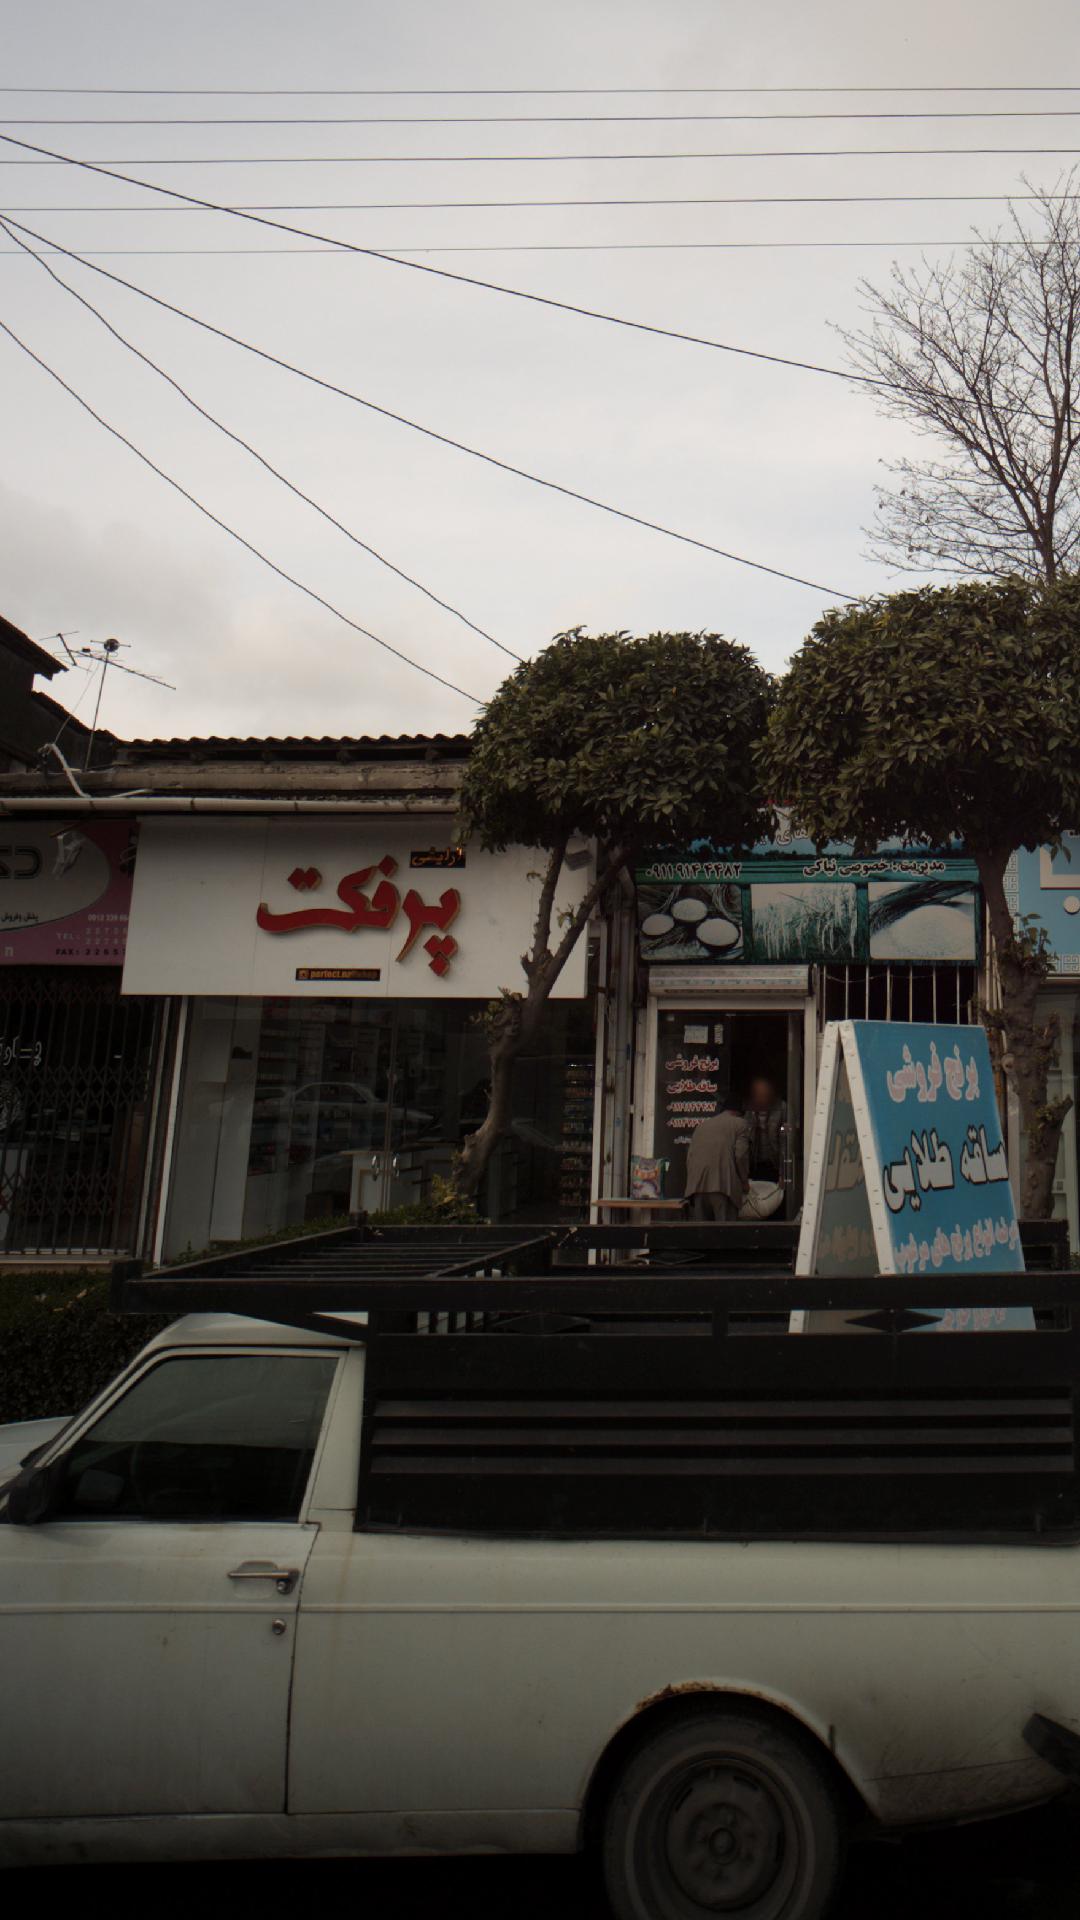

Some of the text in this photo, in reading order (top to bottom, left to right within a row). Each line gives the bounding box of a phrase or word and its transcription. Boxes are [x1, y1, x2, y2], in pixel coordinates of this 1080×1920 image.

[839, 858, 889, 877] خصوصی
[256, 855, 461, 977] پرفکت
[886, 1040, 980, 1103] برنج فروشی
[883, 1126, 955, 1214] طلایی
[960, 1123, 1009, 1185] ساقه
